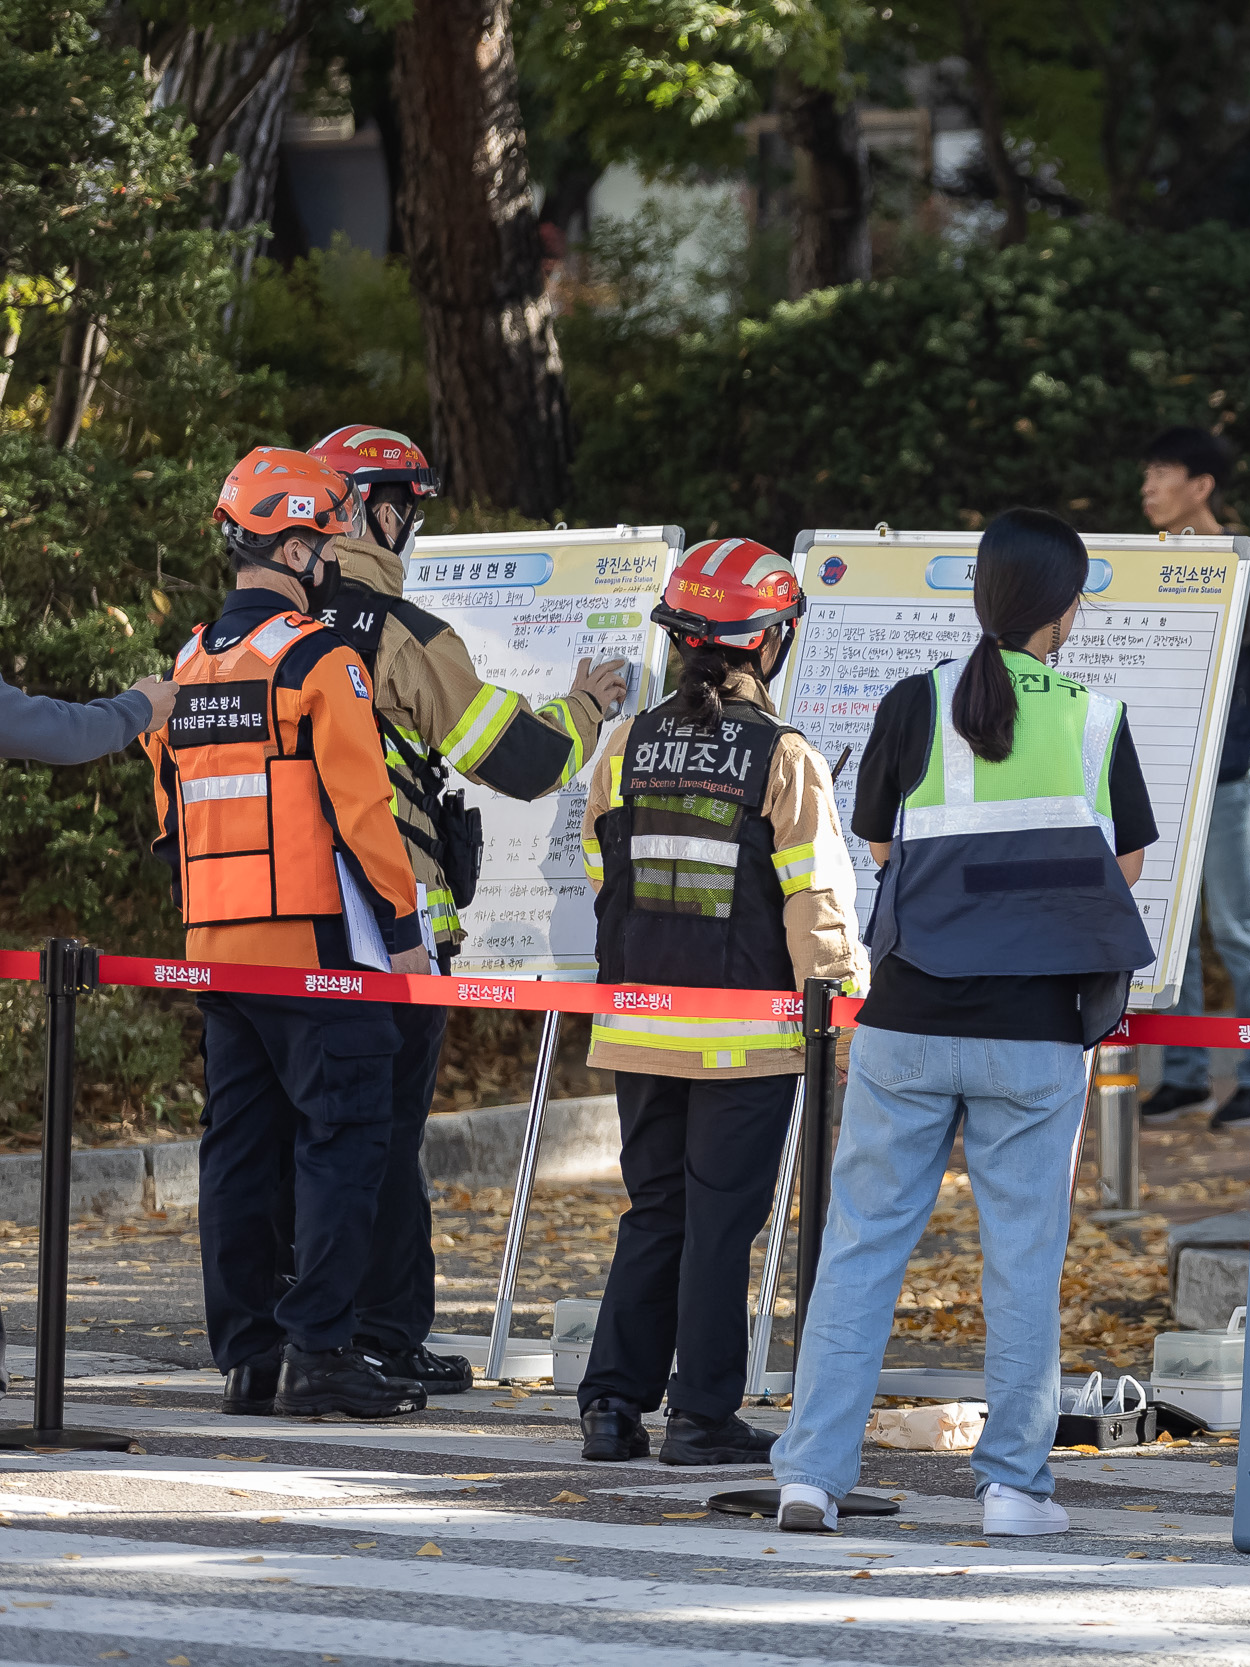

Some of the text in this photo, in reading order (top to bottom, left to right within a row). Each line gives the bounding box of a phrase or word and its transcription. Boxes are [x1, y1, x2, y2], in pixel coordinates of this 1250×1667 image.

[358, 446, 378, 458] 서울
[418, 562, 517, 582] 재난발생현황
[596, 555, 657, 577] 광진소방서
[594, 575, 654, 585] Gwangjin Fire Station
[1160, 565, 1227, 584] 광진소방서
[678, 579, 725, 602] 화재조사
[757, 582, 789, 598] 서울 119
[1158, 584, 1222, 595] Gwangjin Fire Station
[597, 614, 630, 625] 브리핑
[817, 609, 836, 620] 시간
[581, 633, 643, 643] 현재 기준
[810, 627, 839, 639] 13:30
[844, 628, 865, 642] 광진구
[888, 629, 901, 640] 120
[576, 645, 596, 655] 보고자
[806, 646, 921, 660] 13:35 현장도착
[1118, 653, 1146, 666] 현장도착
[486, 667, 507, 679] 연면적
[803, 665, 831, 678] 13:37
[1102, 672, 1117, 685] 실시
[800, 683, 858, 698] 13:37 지휘차
[190, 695, 241, 711] 광진소방서
[798, 702, 824, 714] 13:43
[172, 713, 262, 731] 119긴급구조통제단
[633, 742, 752, 781] 화재조사
[629, 777, 744, 796] Fire Scene Investigation
[508, 836, 564, 848] 가스 기타
[506, 851, 562, 862] 가스 기타
[154, 966, 211, 985] 광진소방서
[305, 975, 362, 993] 광진소방서
[458, 982, 515, 1004] 광진소방서
[613, 992, 672, 1010] 광진소방서
